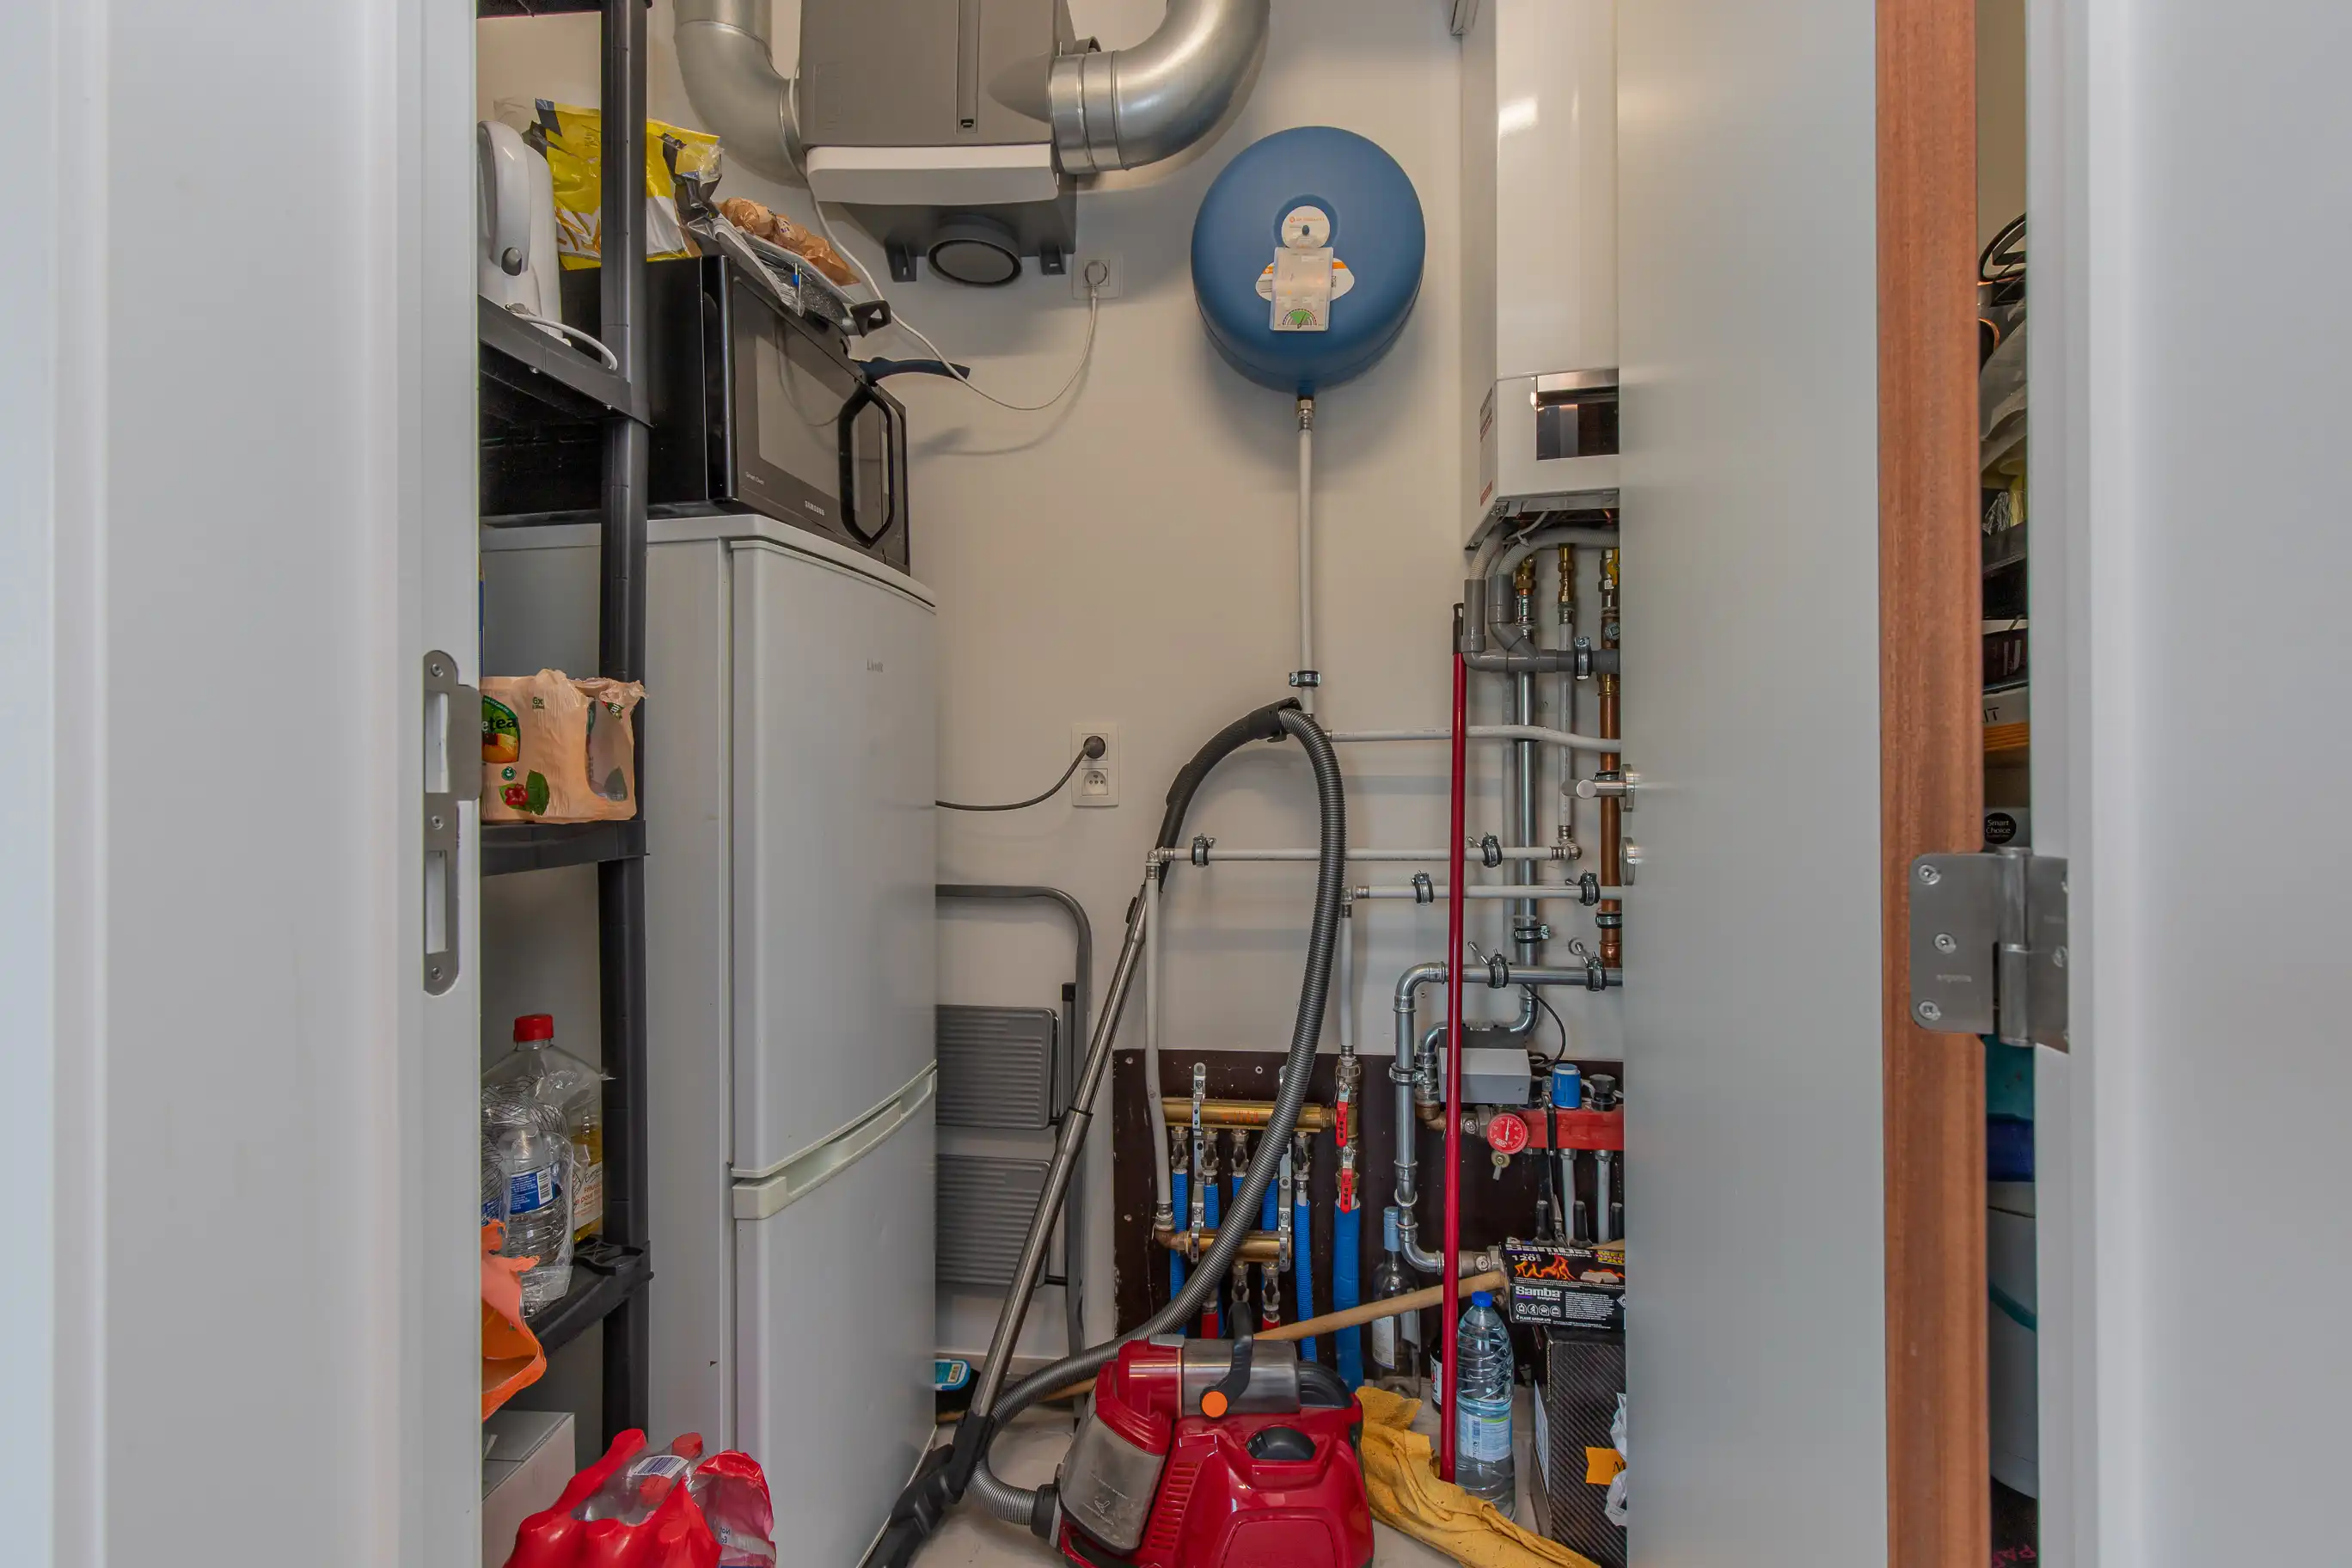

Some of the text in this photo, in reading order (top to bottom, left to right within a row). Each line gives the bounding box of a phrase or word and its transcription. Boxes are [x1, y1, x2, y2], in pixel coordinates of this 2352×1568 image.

[1982, 707, 2000, 724] IT
[1506, 1244, 1591, 1255] Samba
[1516, 1286, 1561, 1298] Samba
